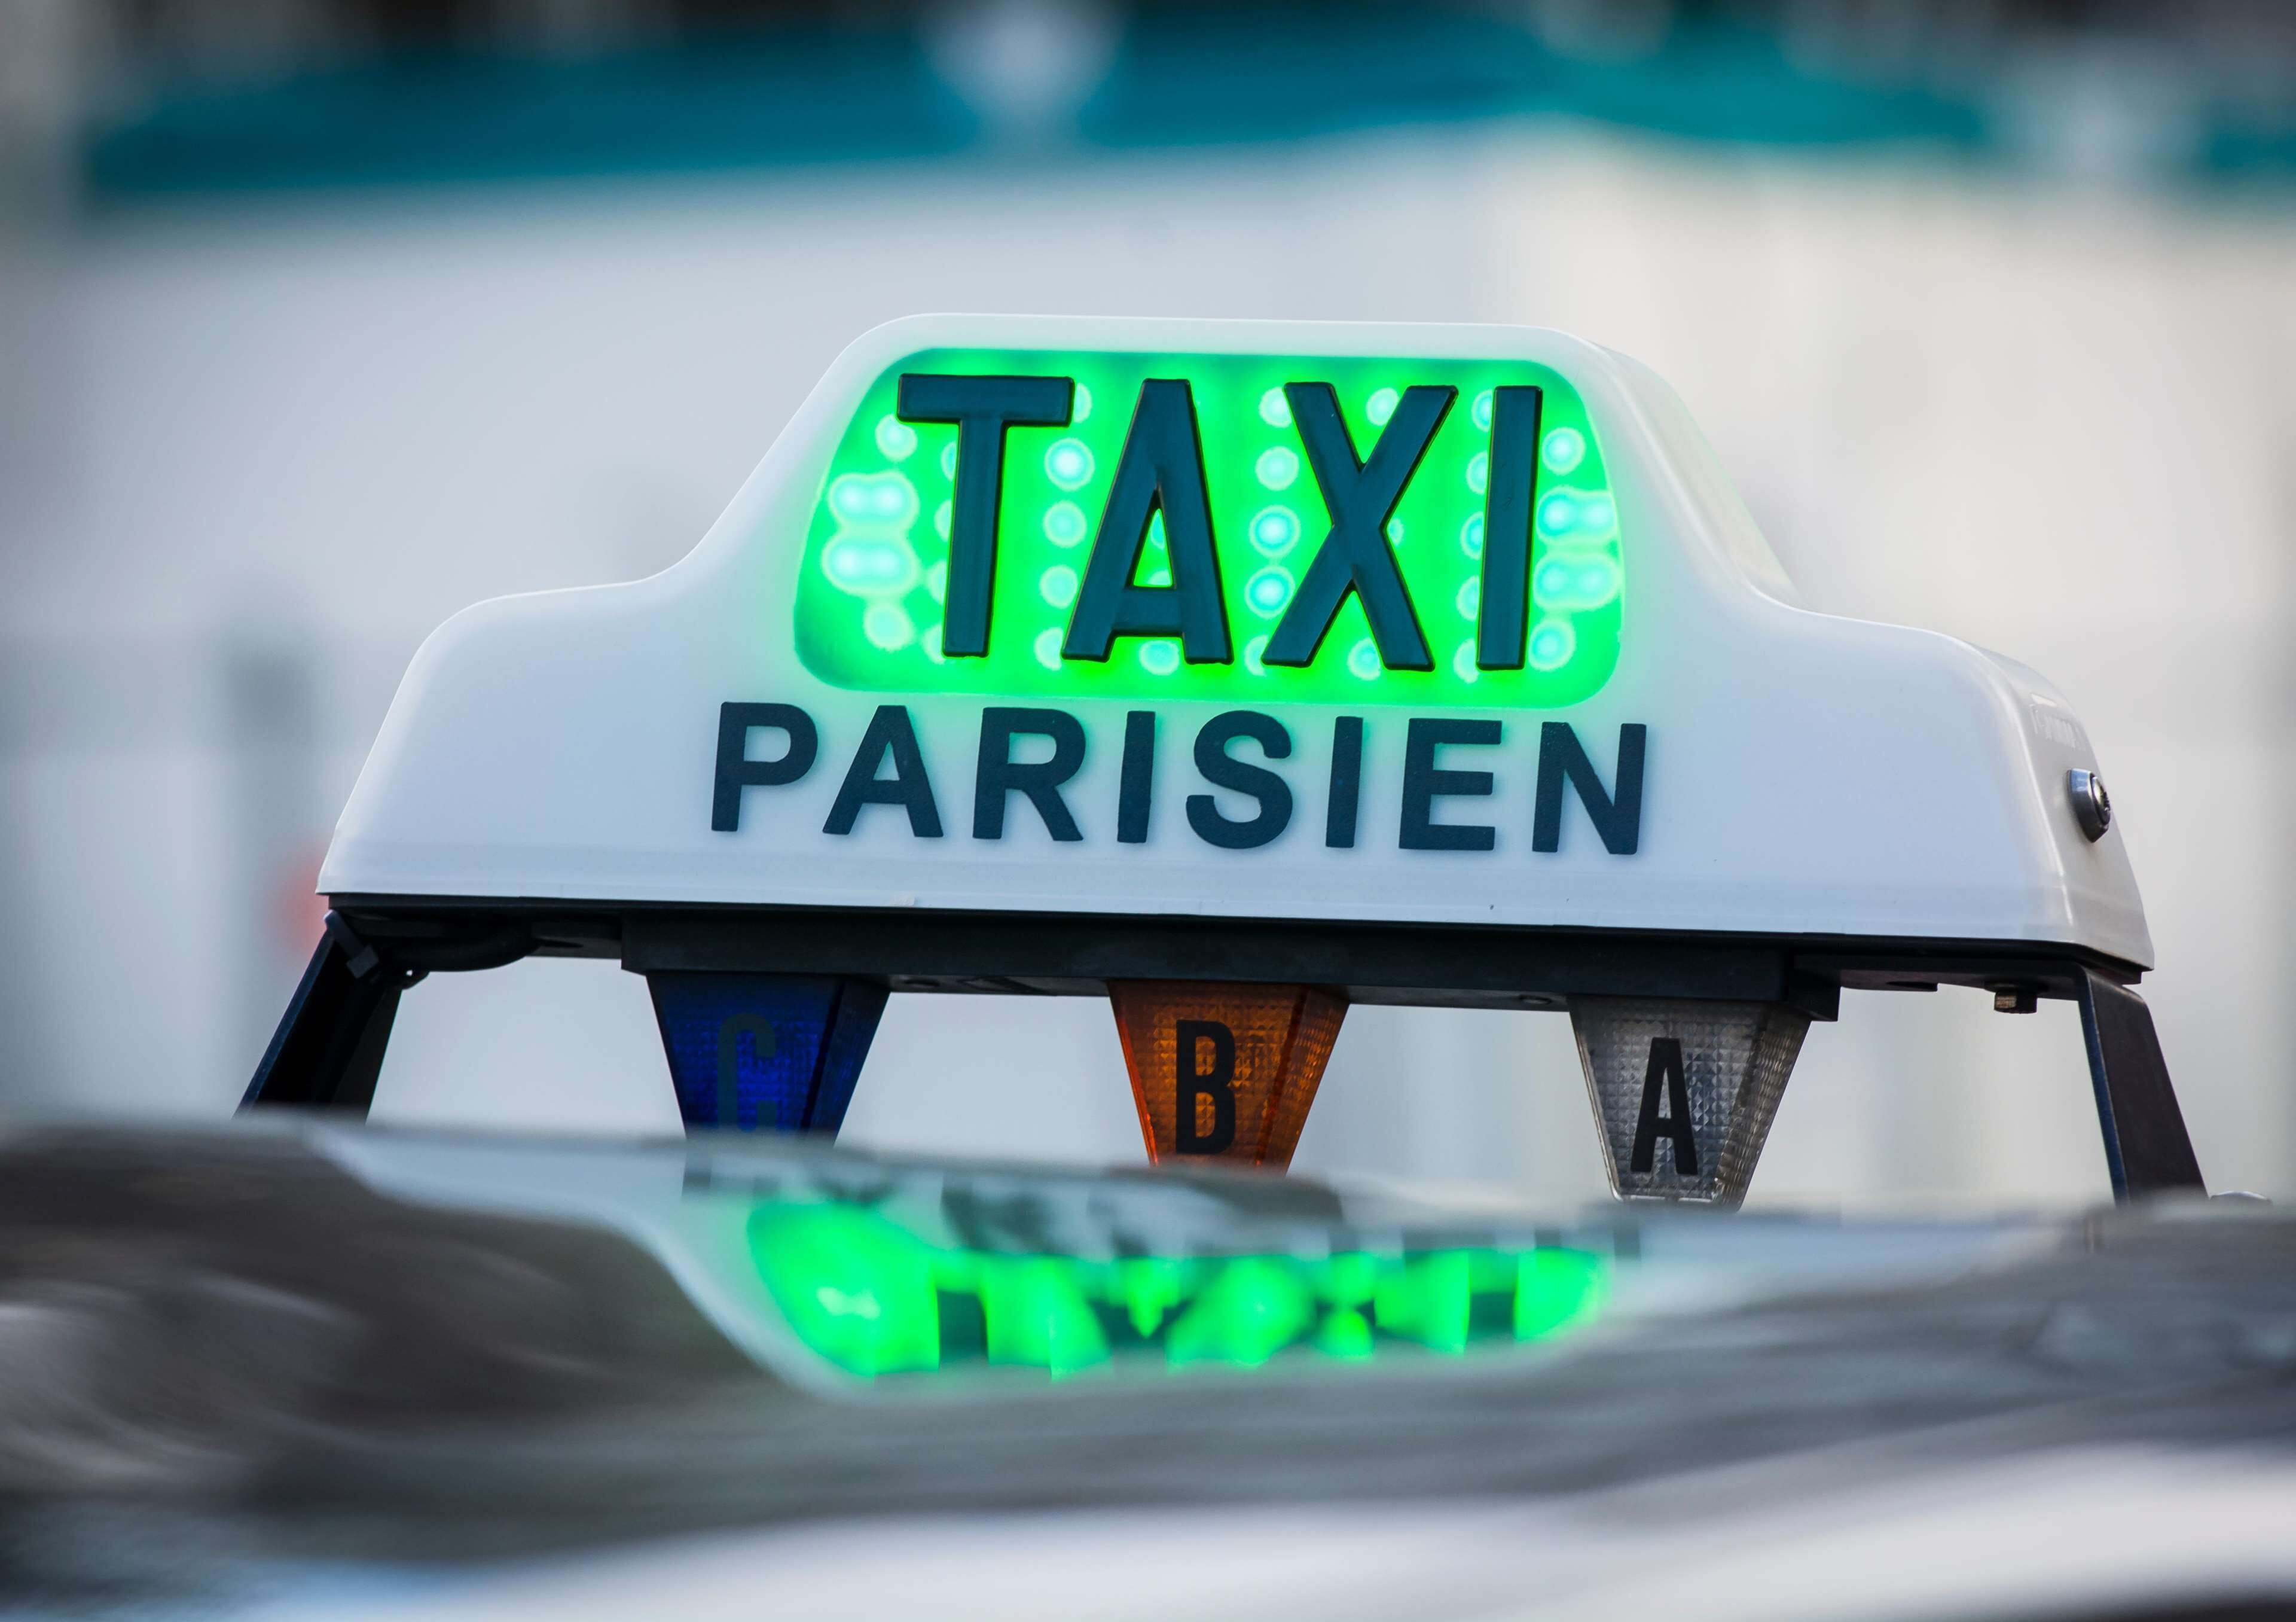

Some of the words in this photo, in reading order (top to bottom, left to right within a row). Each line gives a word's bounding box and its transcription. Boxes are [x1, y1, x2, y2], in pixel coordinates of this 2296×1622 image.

[897, 373, 1544, 672] TAXI
[712, 702, 1647, 855] PARISIEN
[717, 1013, 777, 1134] C
[1176, 1020, 1236, 1155] B
[1630, 1036, 1699, 1176] A
